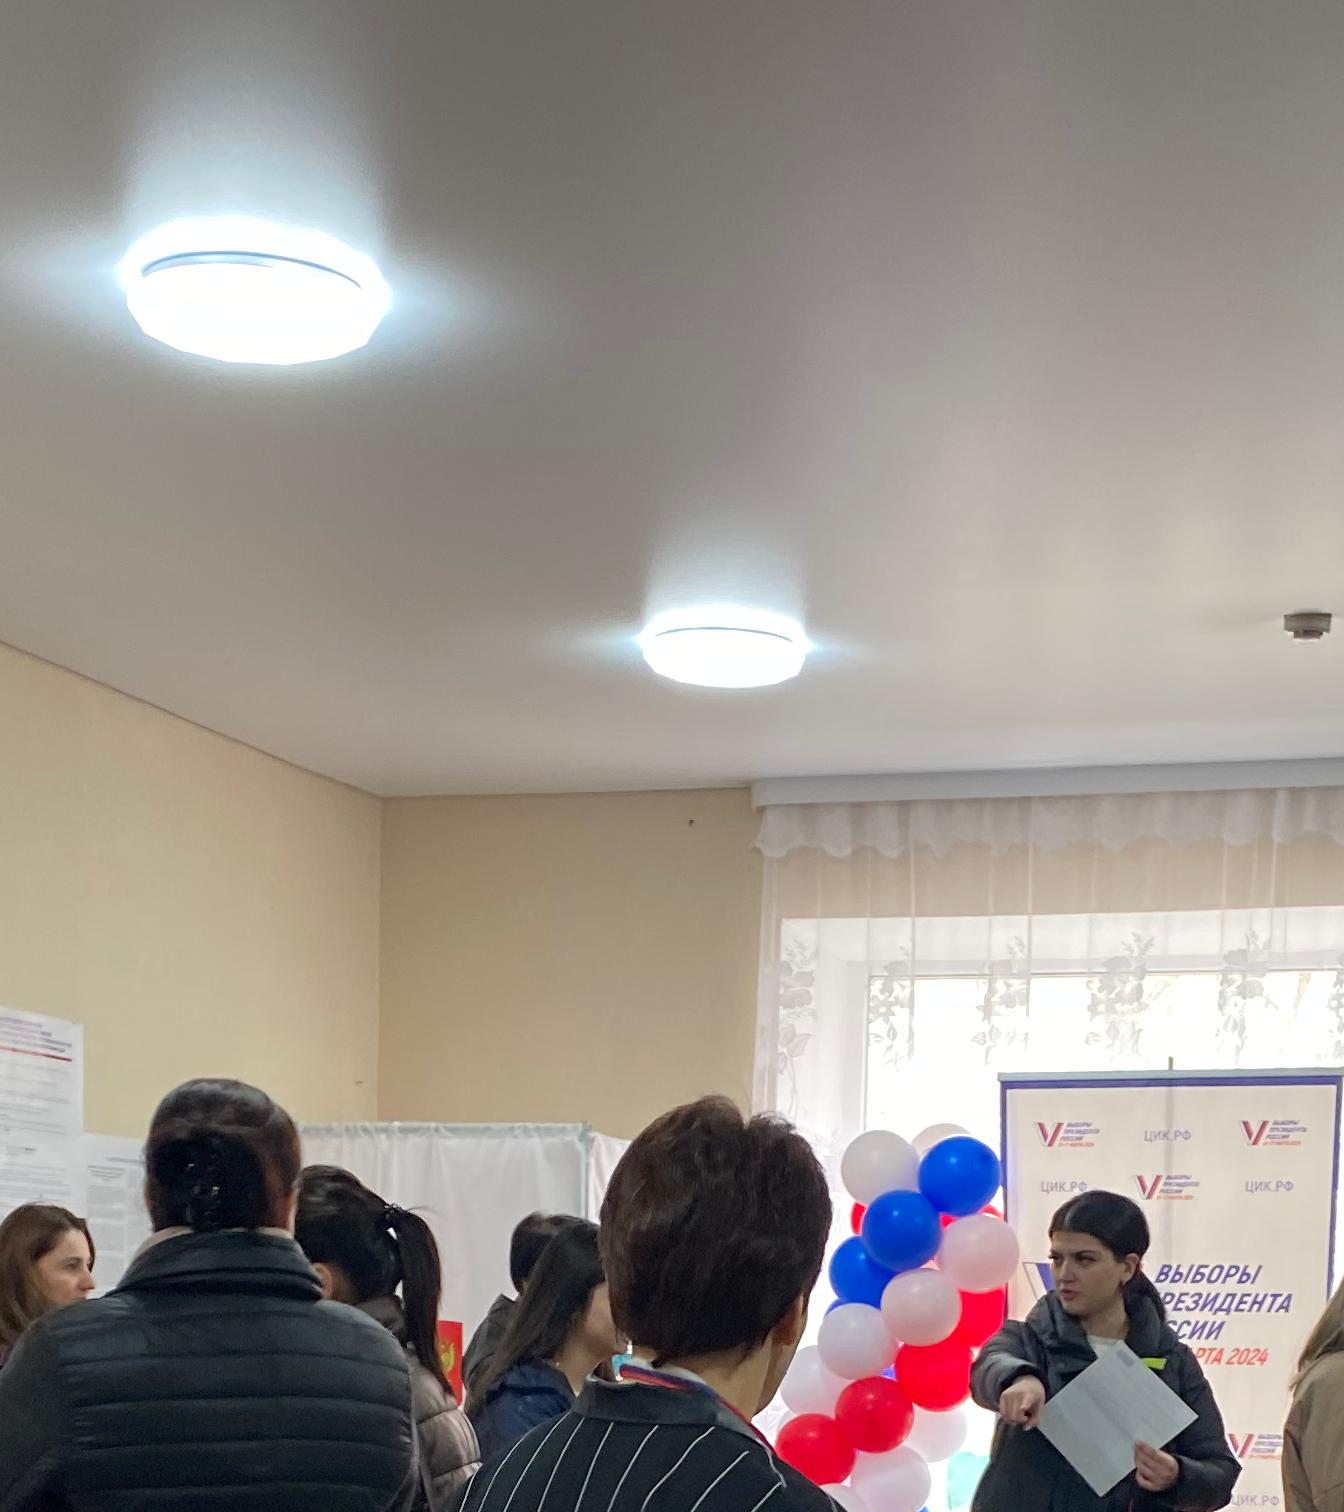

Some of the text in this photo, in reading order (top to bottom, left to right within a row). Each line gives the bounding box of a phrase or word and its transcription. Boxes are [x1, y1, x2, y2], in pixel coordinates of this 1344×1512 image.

[1144, 1130, 1192, 1142] ЦИК.РФ
[1040, 1181, 1088, 1194] ЦИК.РФ
[1245, 1180, 1294, 1193] ЦИК.РФ
[1155, 1264, 1263, 1284] ВЫБОРЫ
[1160, 1292, 1293, 1315] РЕЗИДЕНТА
[1196, 1347, 1269, 1366] РТА 2024
